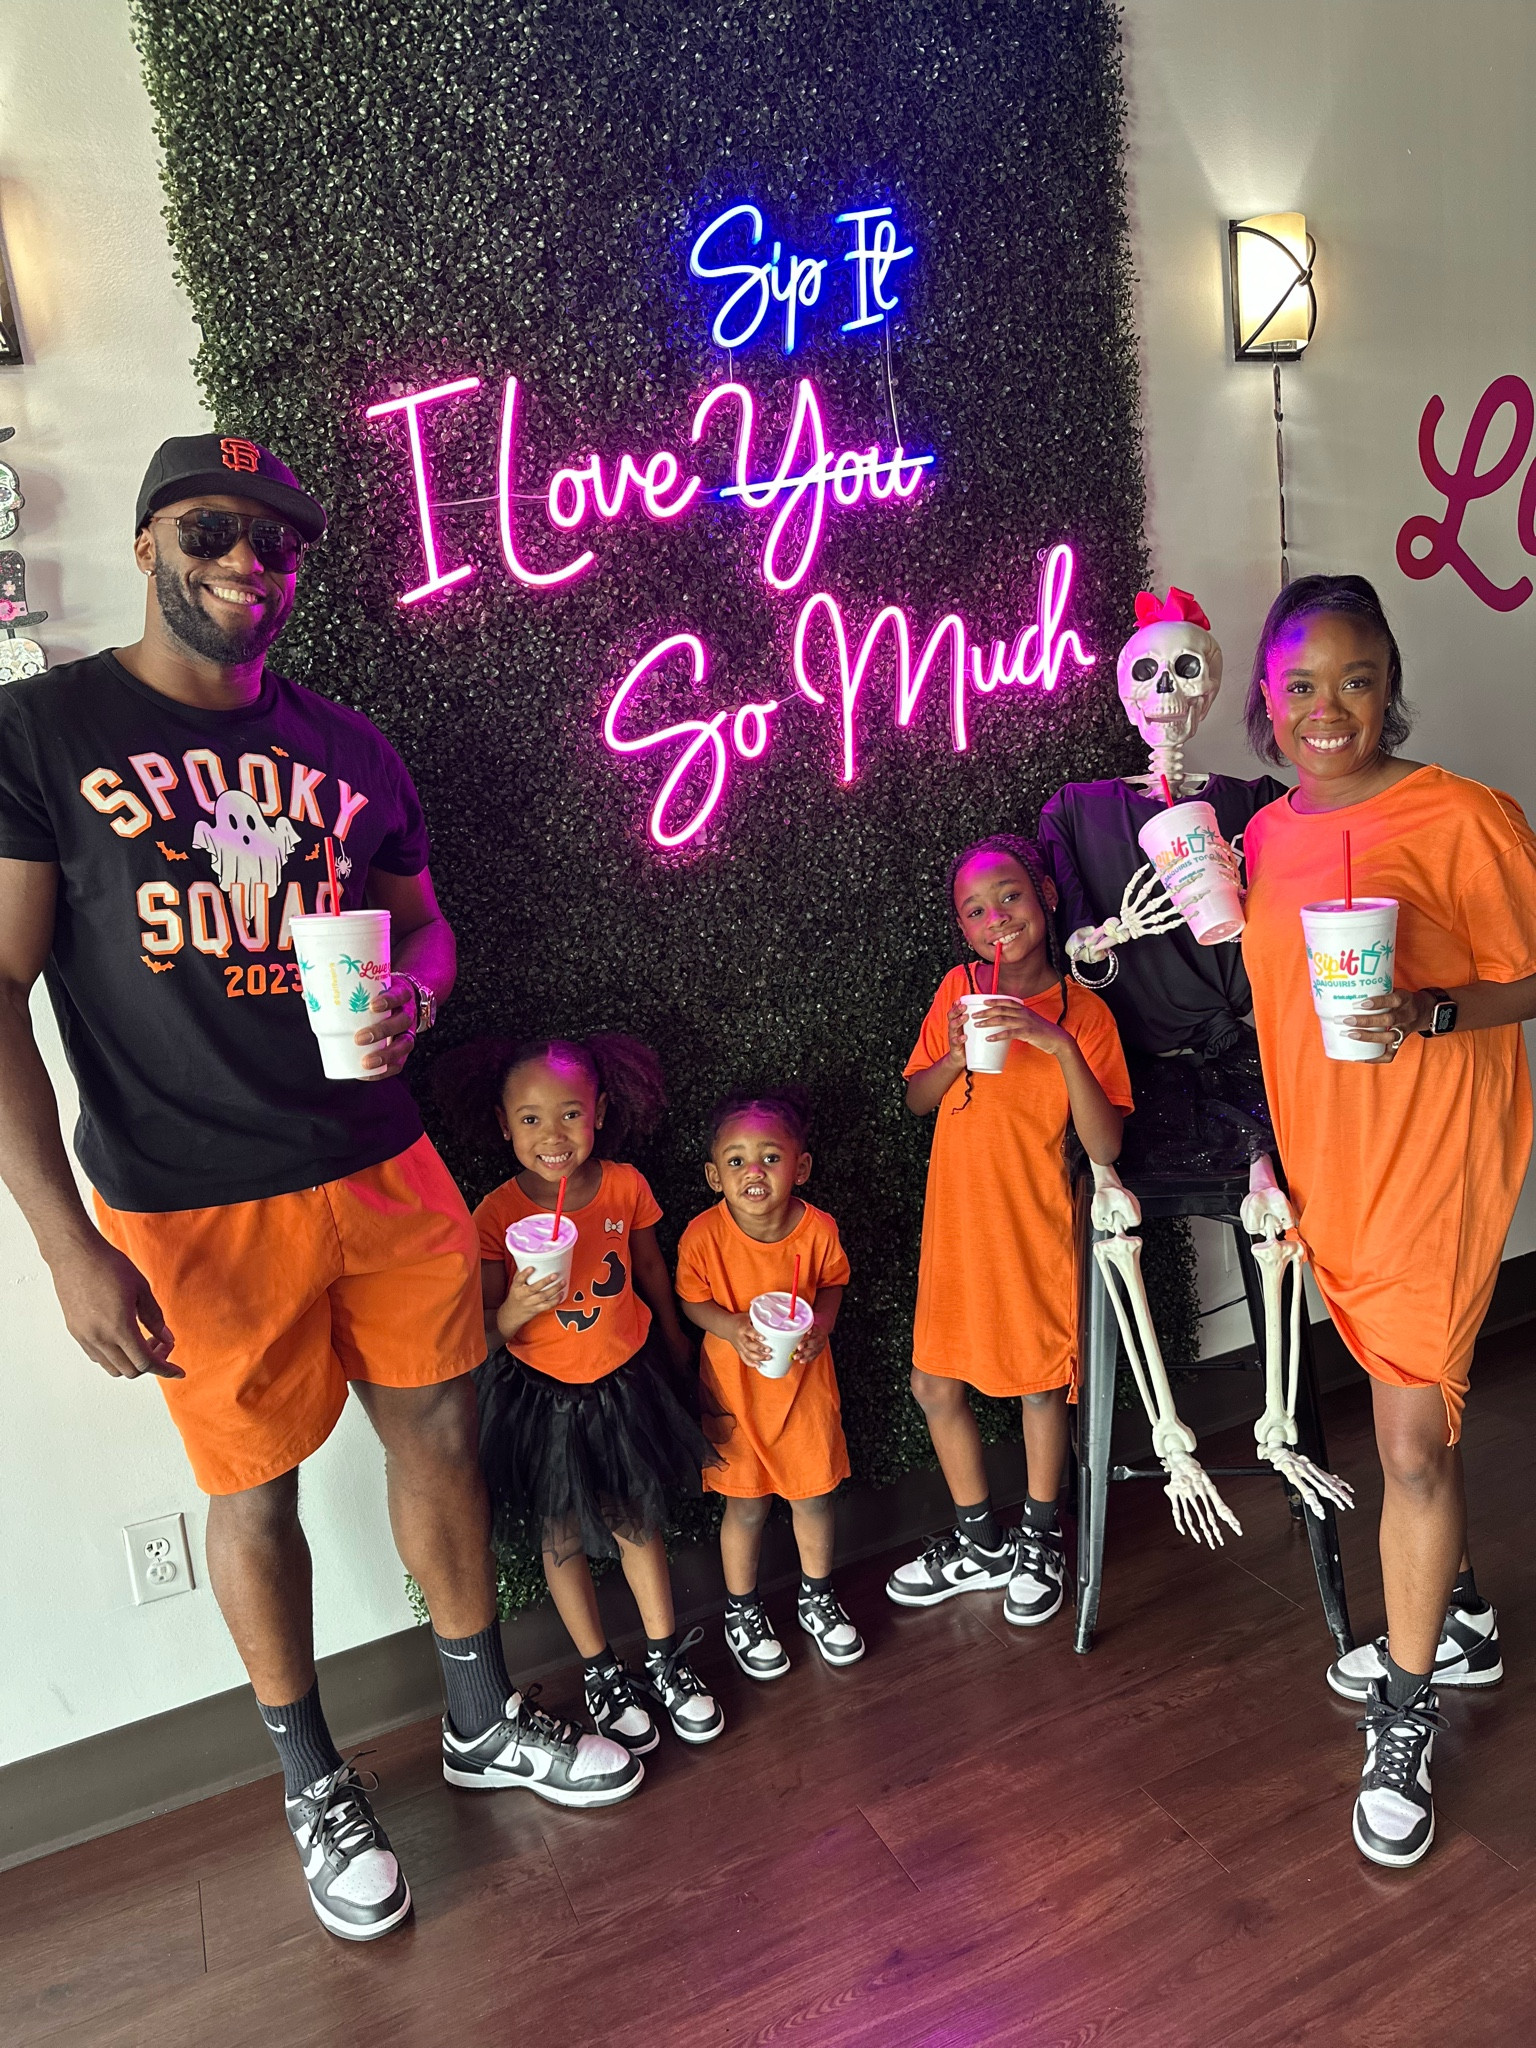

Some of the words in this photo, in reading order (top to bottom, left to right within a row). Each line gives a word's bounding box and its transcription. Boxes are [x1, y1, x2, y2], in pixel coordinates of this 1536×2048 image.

[690, 204, 826, 353] Sip
[836, 206, 913, 331] It
[366, 377, 480, 604] I
[502, 376, 701, 586] Love
[691, 378, 922, 591] You
[604, 633, 778, 847] So
[795, 544, 1095, 782] Much
[80, 748, 369, 842] SPOOKY
[1359, 976, 1383, 986] TOGO
